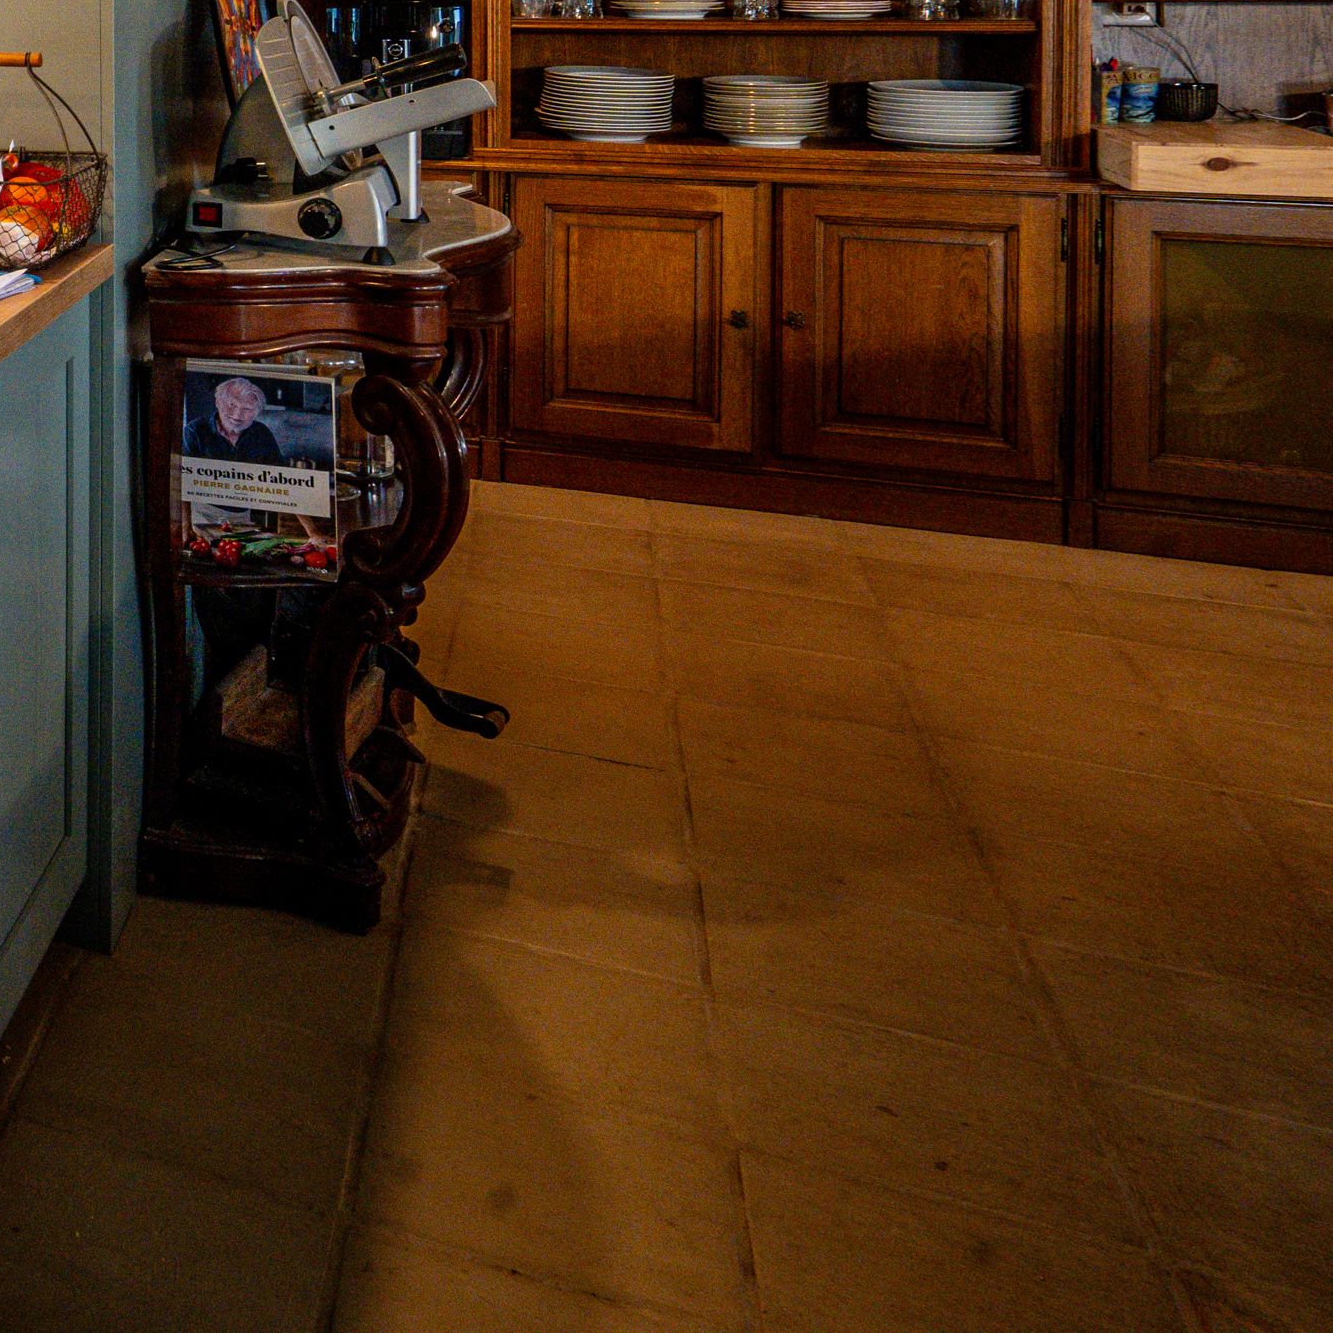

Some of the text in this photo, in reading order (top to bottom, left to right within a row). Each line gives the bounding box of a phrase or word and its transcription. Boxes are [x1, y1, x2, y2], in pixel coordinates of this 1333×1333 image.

[181, 465, 315, 488] es copains d'abord
[193, 479, 290, 497] PIERRE GAGNAIRE
[225, 495, 249, 503] FACILES
